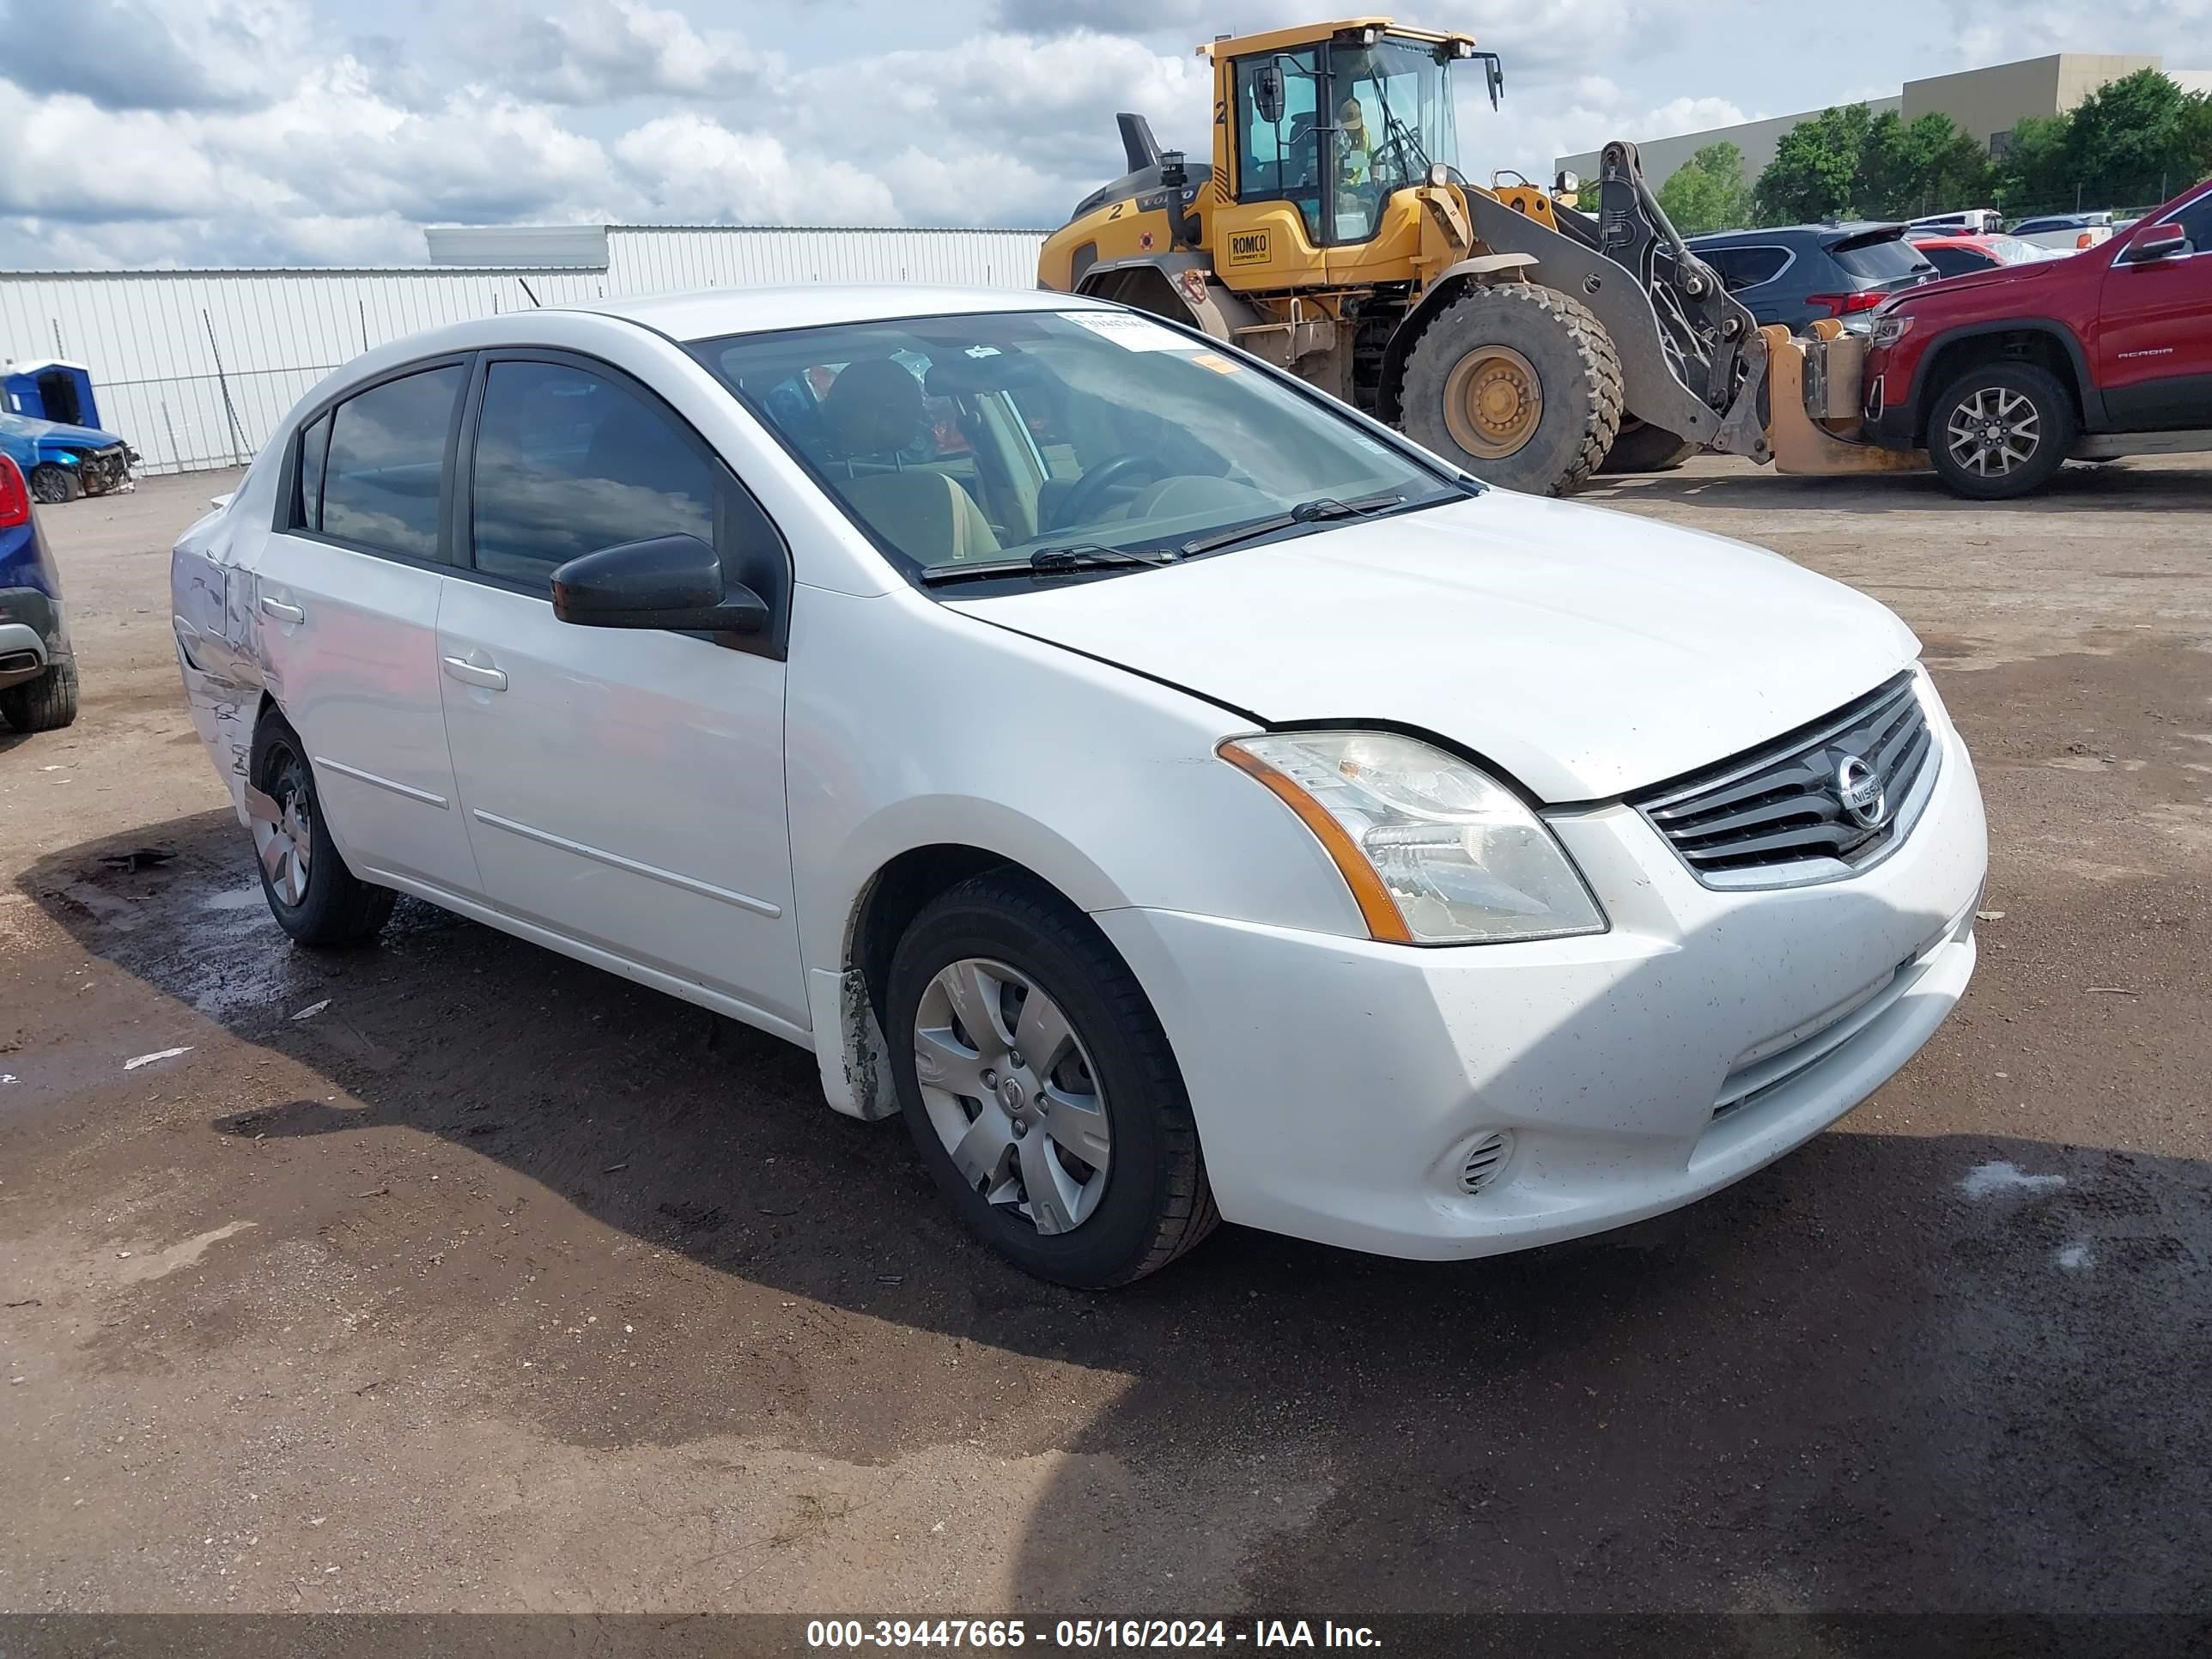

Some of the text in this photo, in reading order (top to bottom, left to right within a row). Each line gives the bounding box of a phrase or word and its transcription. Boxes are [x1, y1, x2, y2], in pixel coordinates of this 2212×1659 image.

[1215, 101, 1227, 124] 2
[1142, 190, 1194, 206] VOLO
[1109, 204, 1124, 221] 2
[1233, 234, 1267, 255] ROMCO
[2118, 348, 2173, 359] ACADIA
[1851, 780, 1881, 804] NISSA
